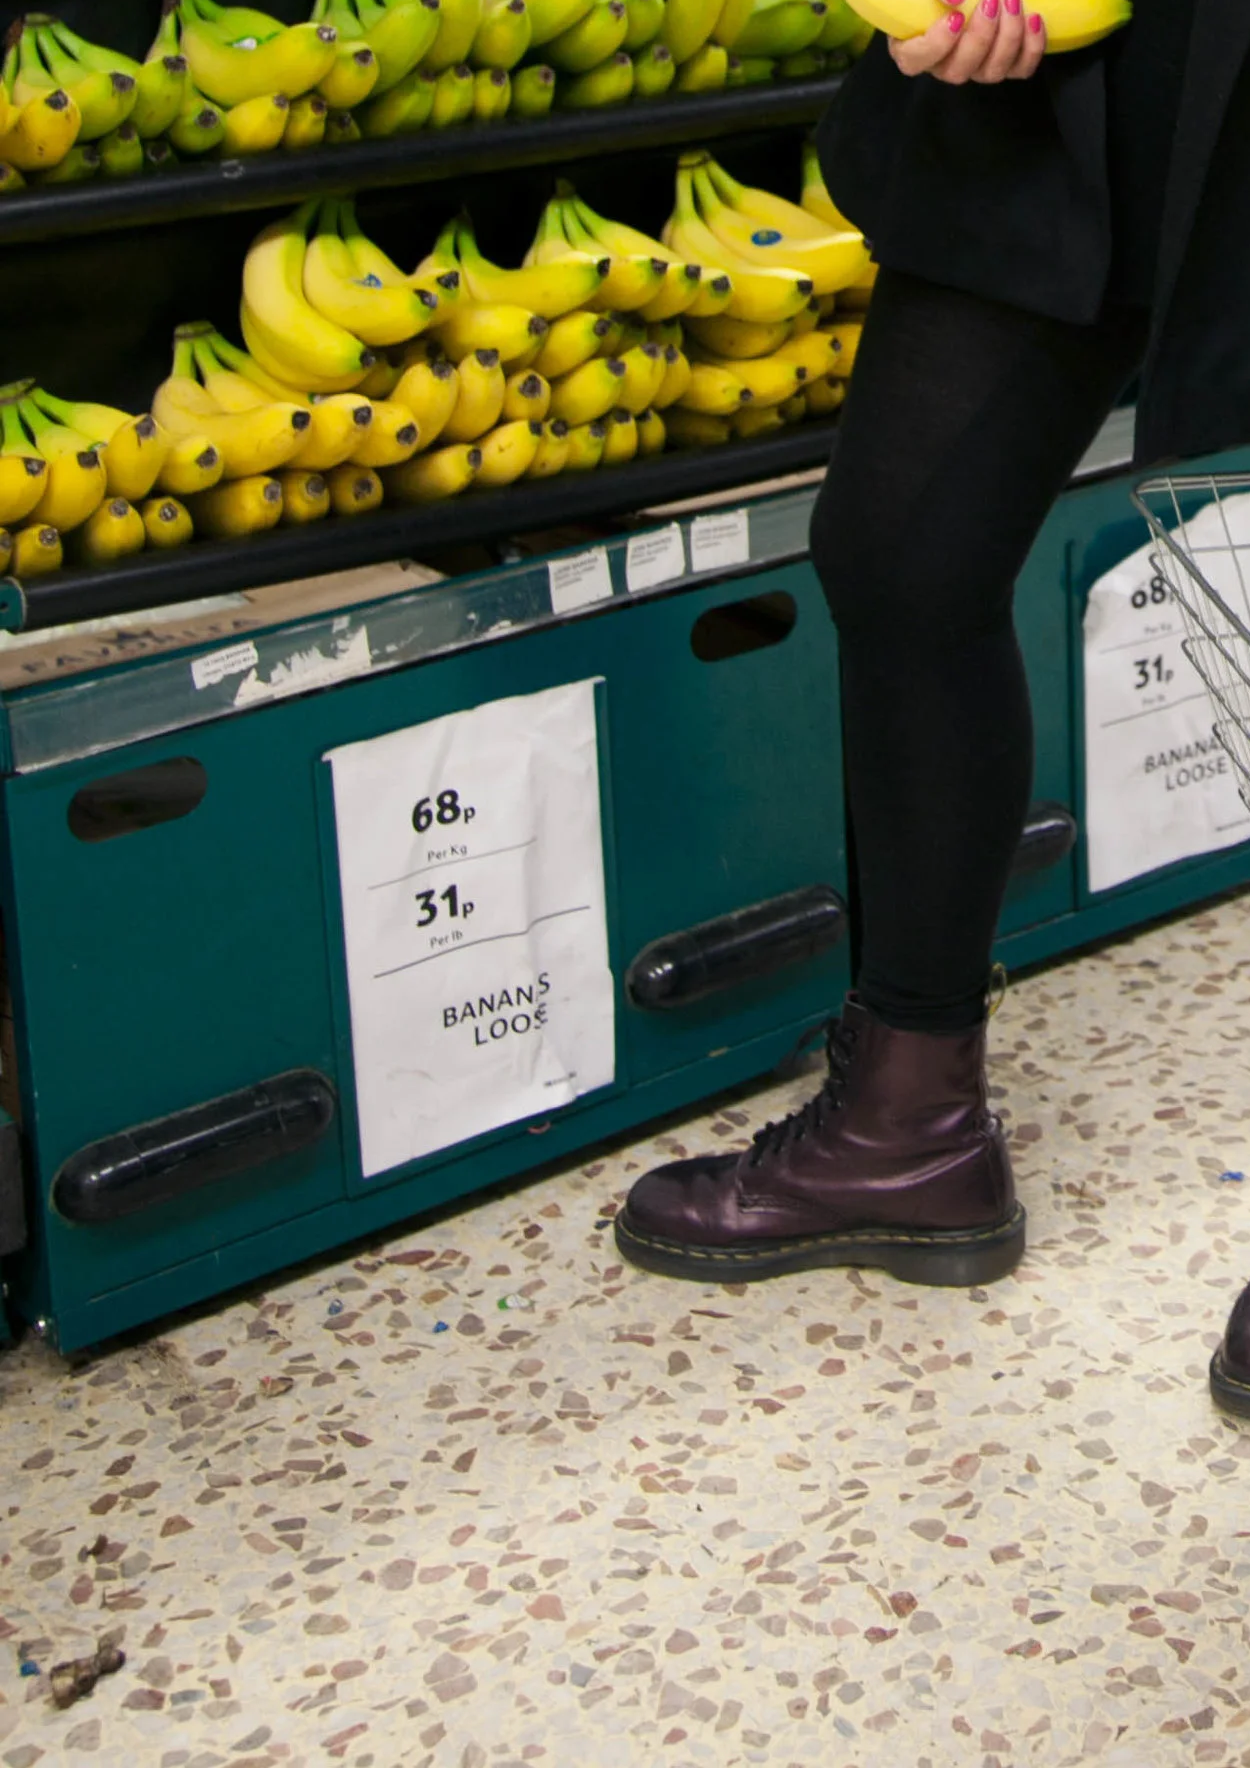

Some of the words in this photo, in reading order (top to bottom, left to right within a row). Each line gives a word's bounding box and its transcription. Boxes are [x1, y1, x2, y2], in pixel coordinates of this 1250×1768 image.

[1133, 653, 1174, 689] 31p
[1145, 735, 1224, 773] BANANA
[1166, 756, 1228, 791] LOOSE
[412, 789, 476, 833] 68p
[427, 850, 447, 862] Per
[450, 845, 467, 857] Kg
[415, 884, 475, 927] 31p
[430, 936, 449, 948] Per
